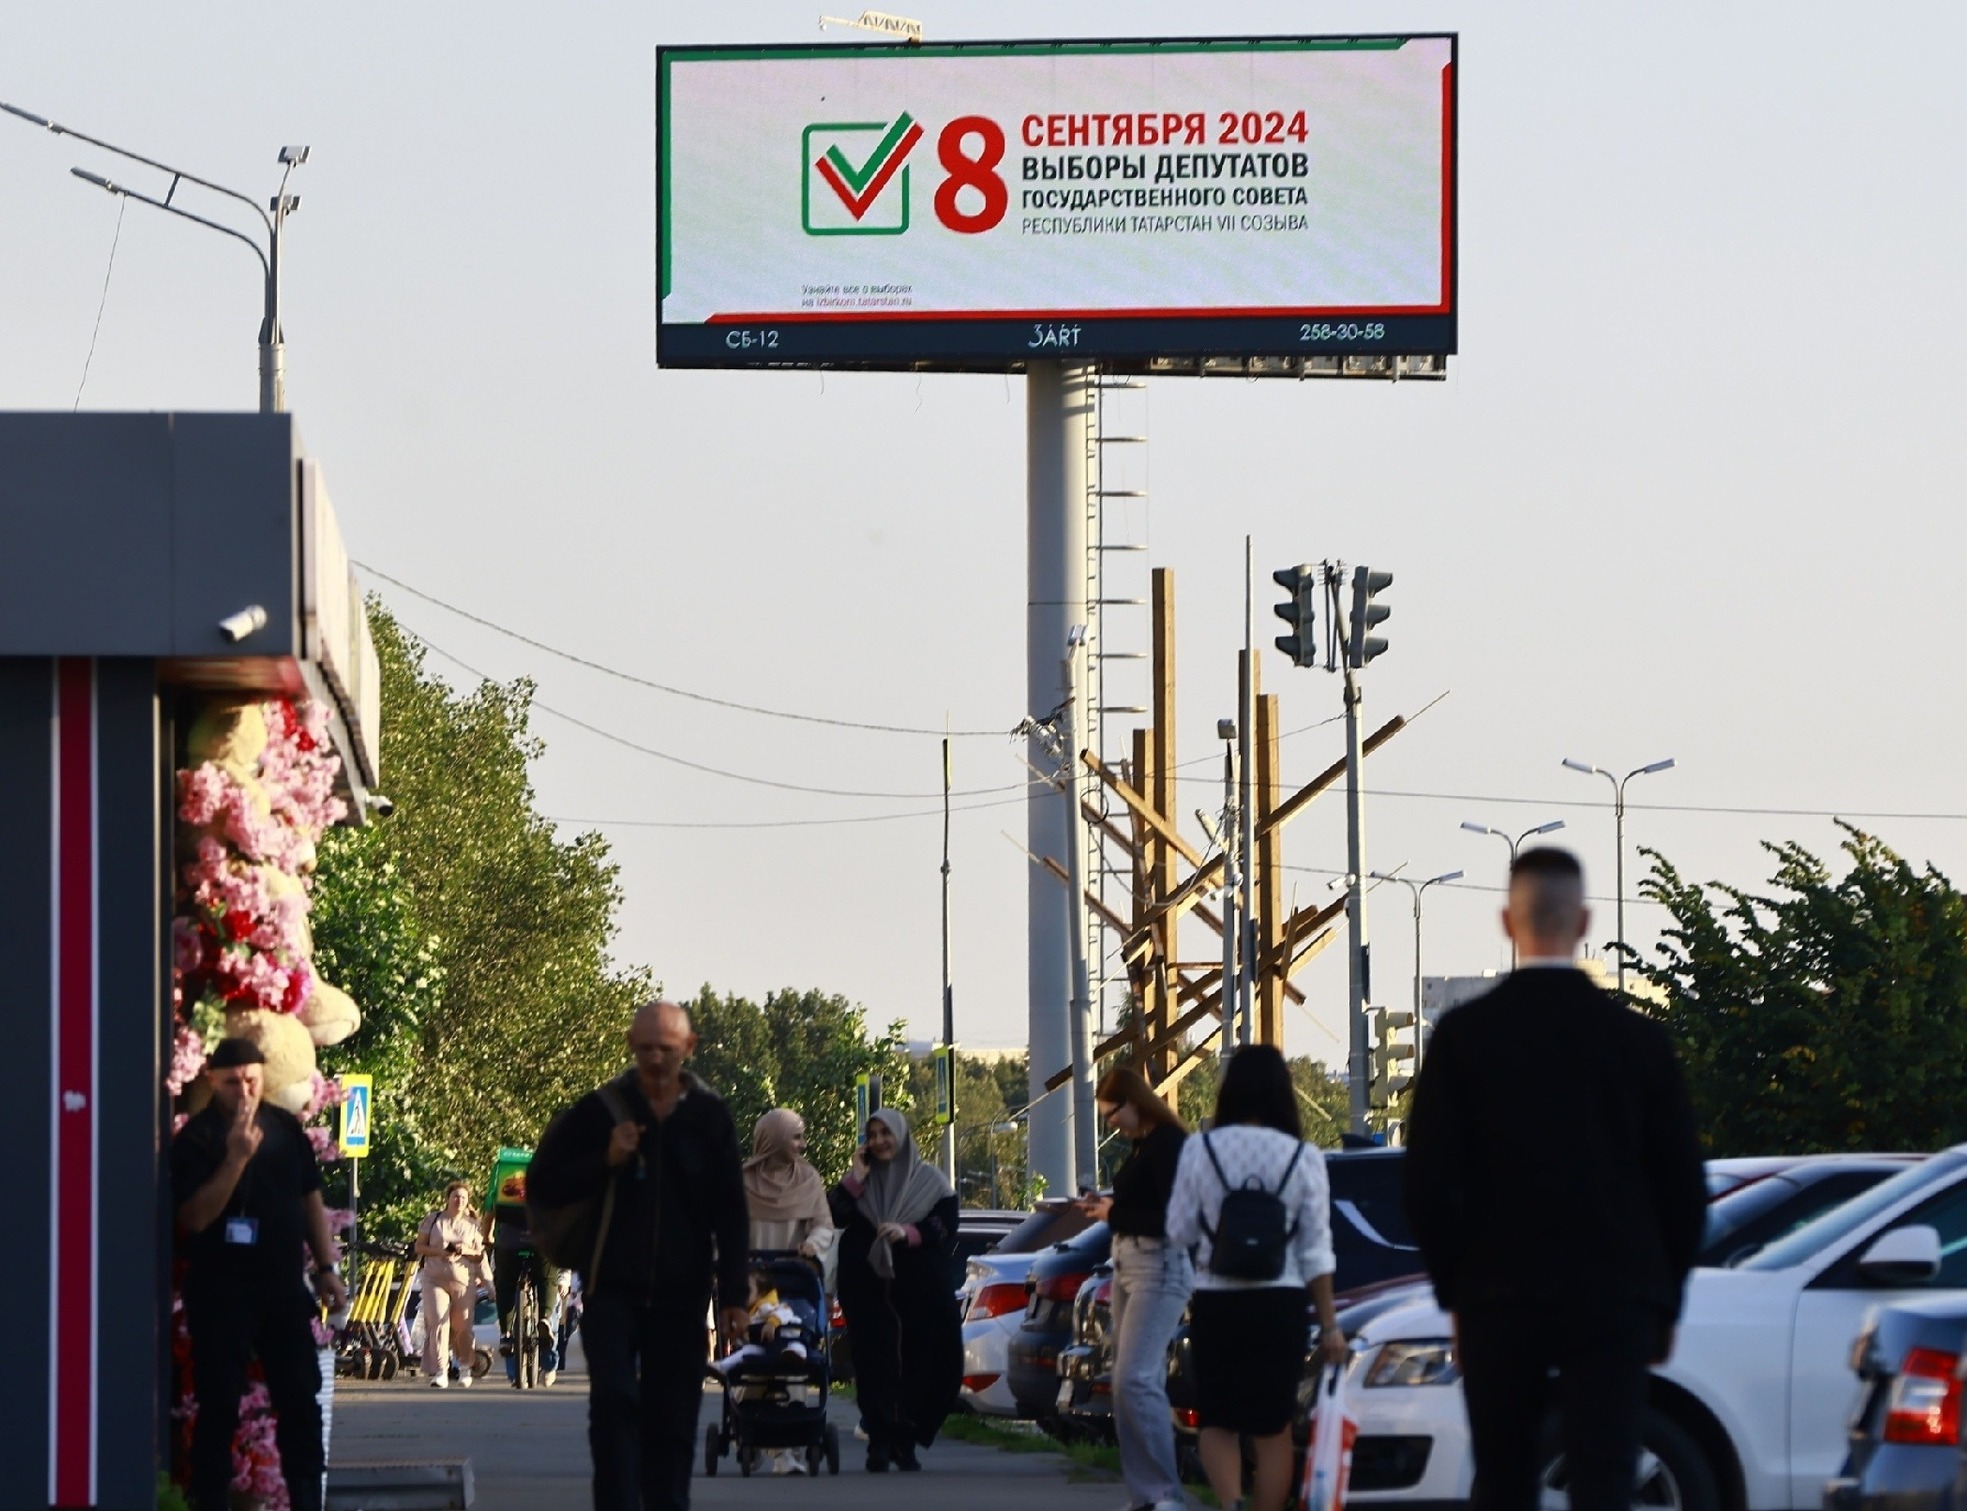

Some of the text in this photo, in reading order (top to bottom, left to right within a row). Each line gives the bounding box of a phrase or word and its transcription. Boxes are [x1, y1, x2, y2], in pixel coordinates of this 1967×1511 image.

[934, 111, 1309, 234] 8 СЕНТЯБРЯ 2024
[1022, 153, 1309, 183] ВЫБОРЫ ДЕПУТАТОВ
[1022, 186, 1309, 210] ГОСУДАРСТВЕННОГО СОВЕТА
[1022, 214, 1309, 235] РЕСПУБЛИКИ ТАТАРСТАН VII СОЗЫВА
[843, 285, 860, 294] все
[725, 330, 779, 349] СБ-12
[1299, 322, 1385, 341] 258-30-58
